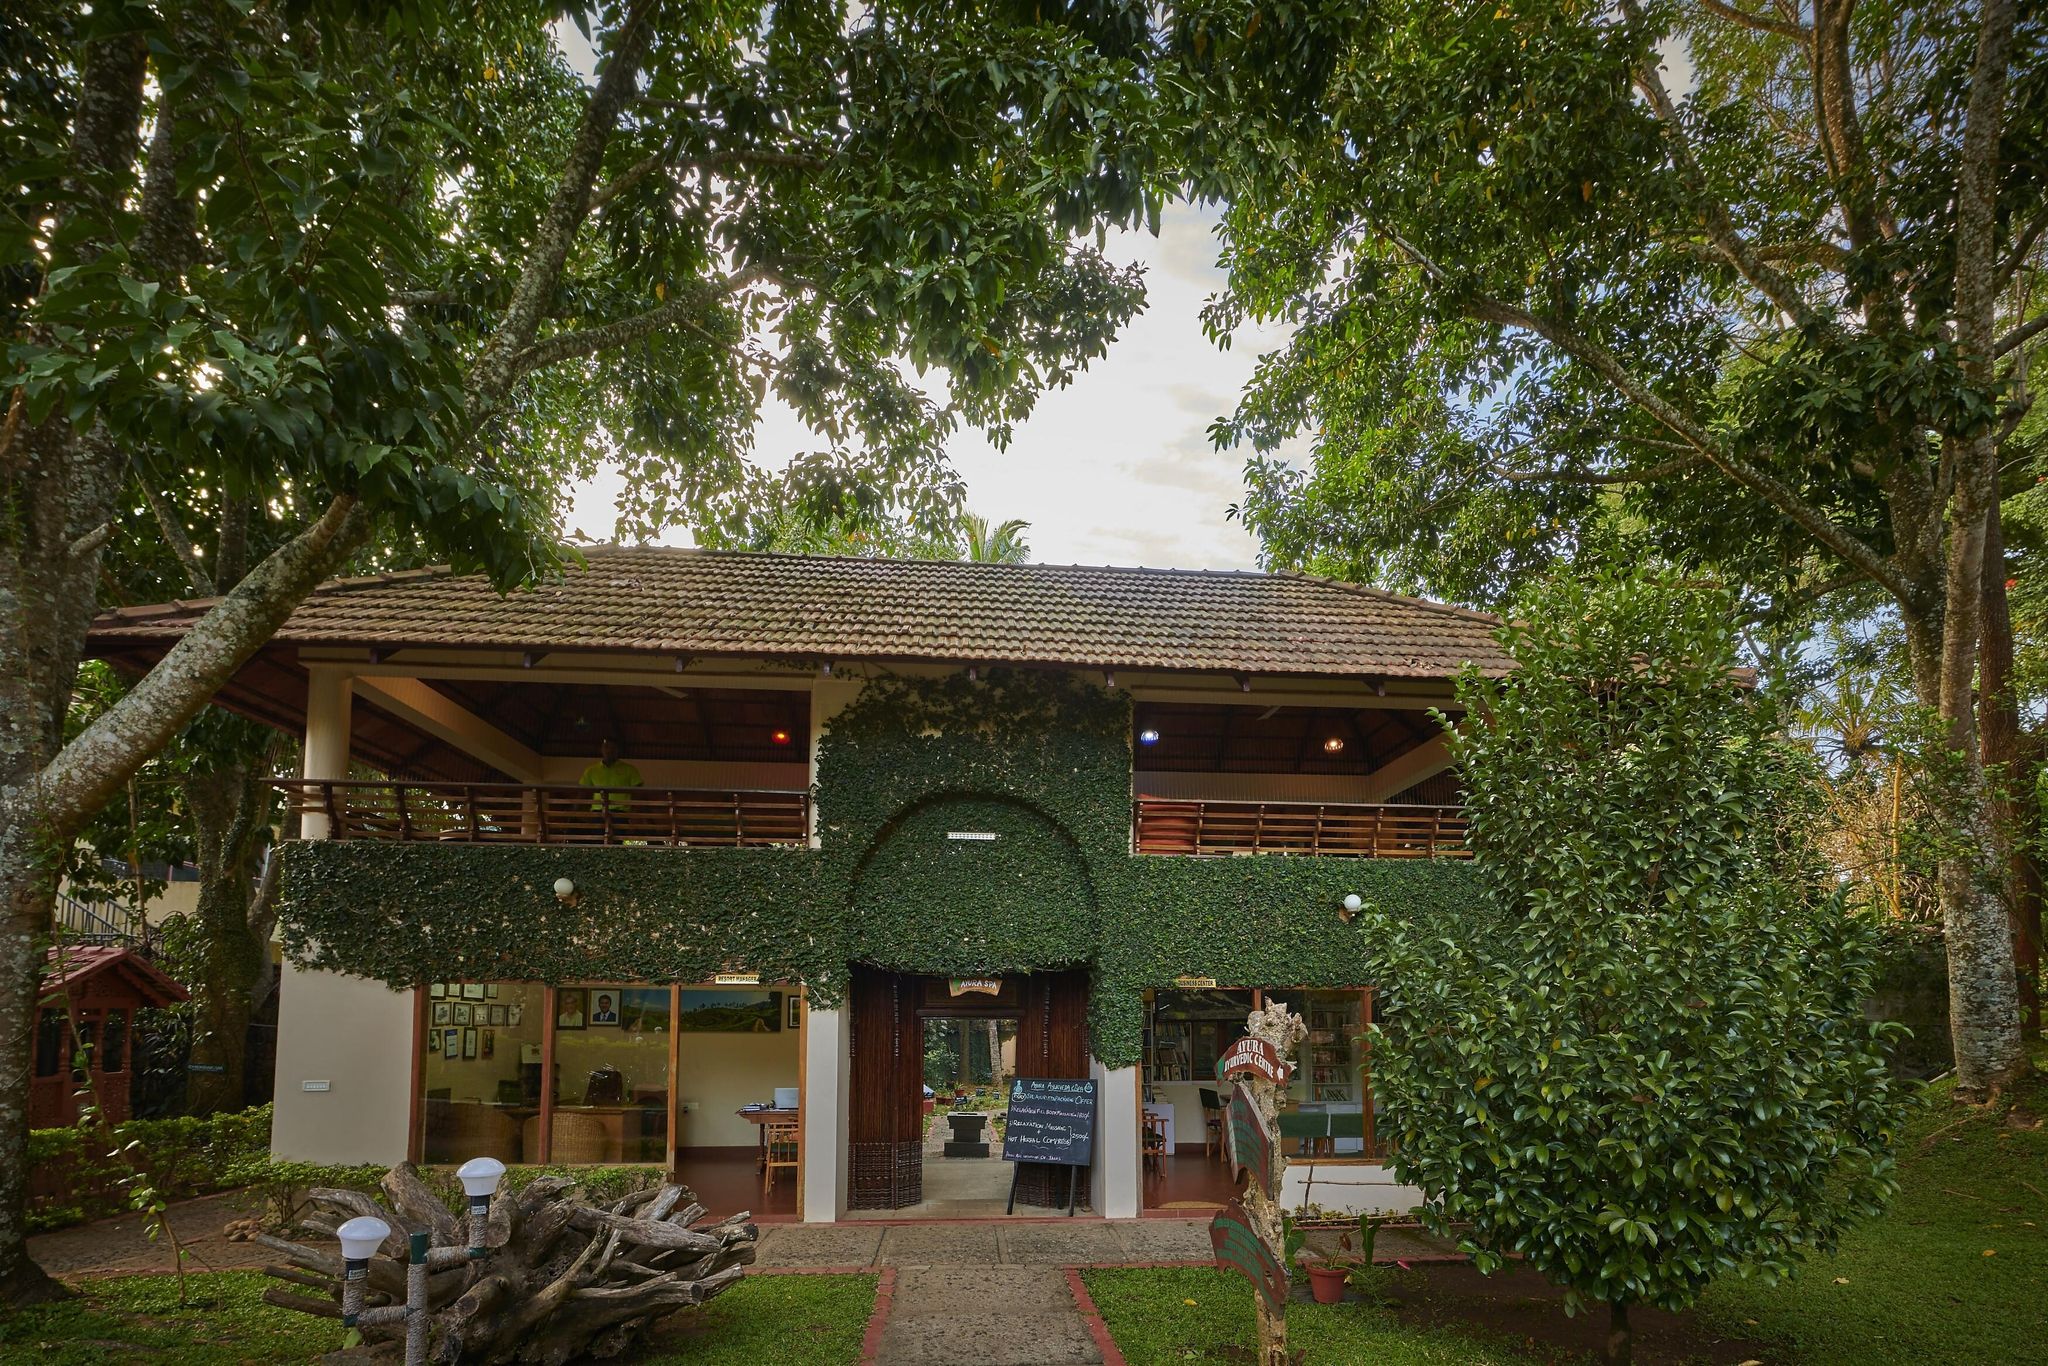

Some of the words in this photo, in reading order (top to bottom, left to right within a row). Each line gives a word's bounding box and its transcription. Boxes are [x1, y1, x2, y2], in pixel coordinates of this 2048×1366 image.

[960, 980, 982, 988] AYURA
[984, 980, 997, 989] SPA
[1236, 1039, 1264, 1056] AYURA
[1074, 1096, 1093, 1105] OFFER
